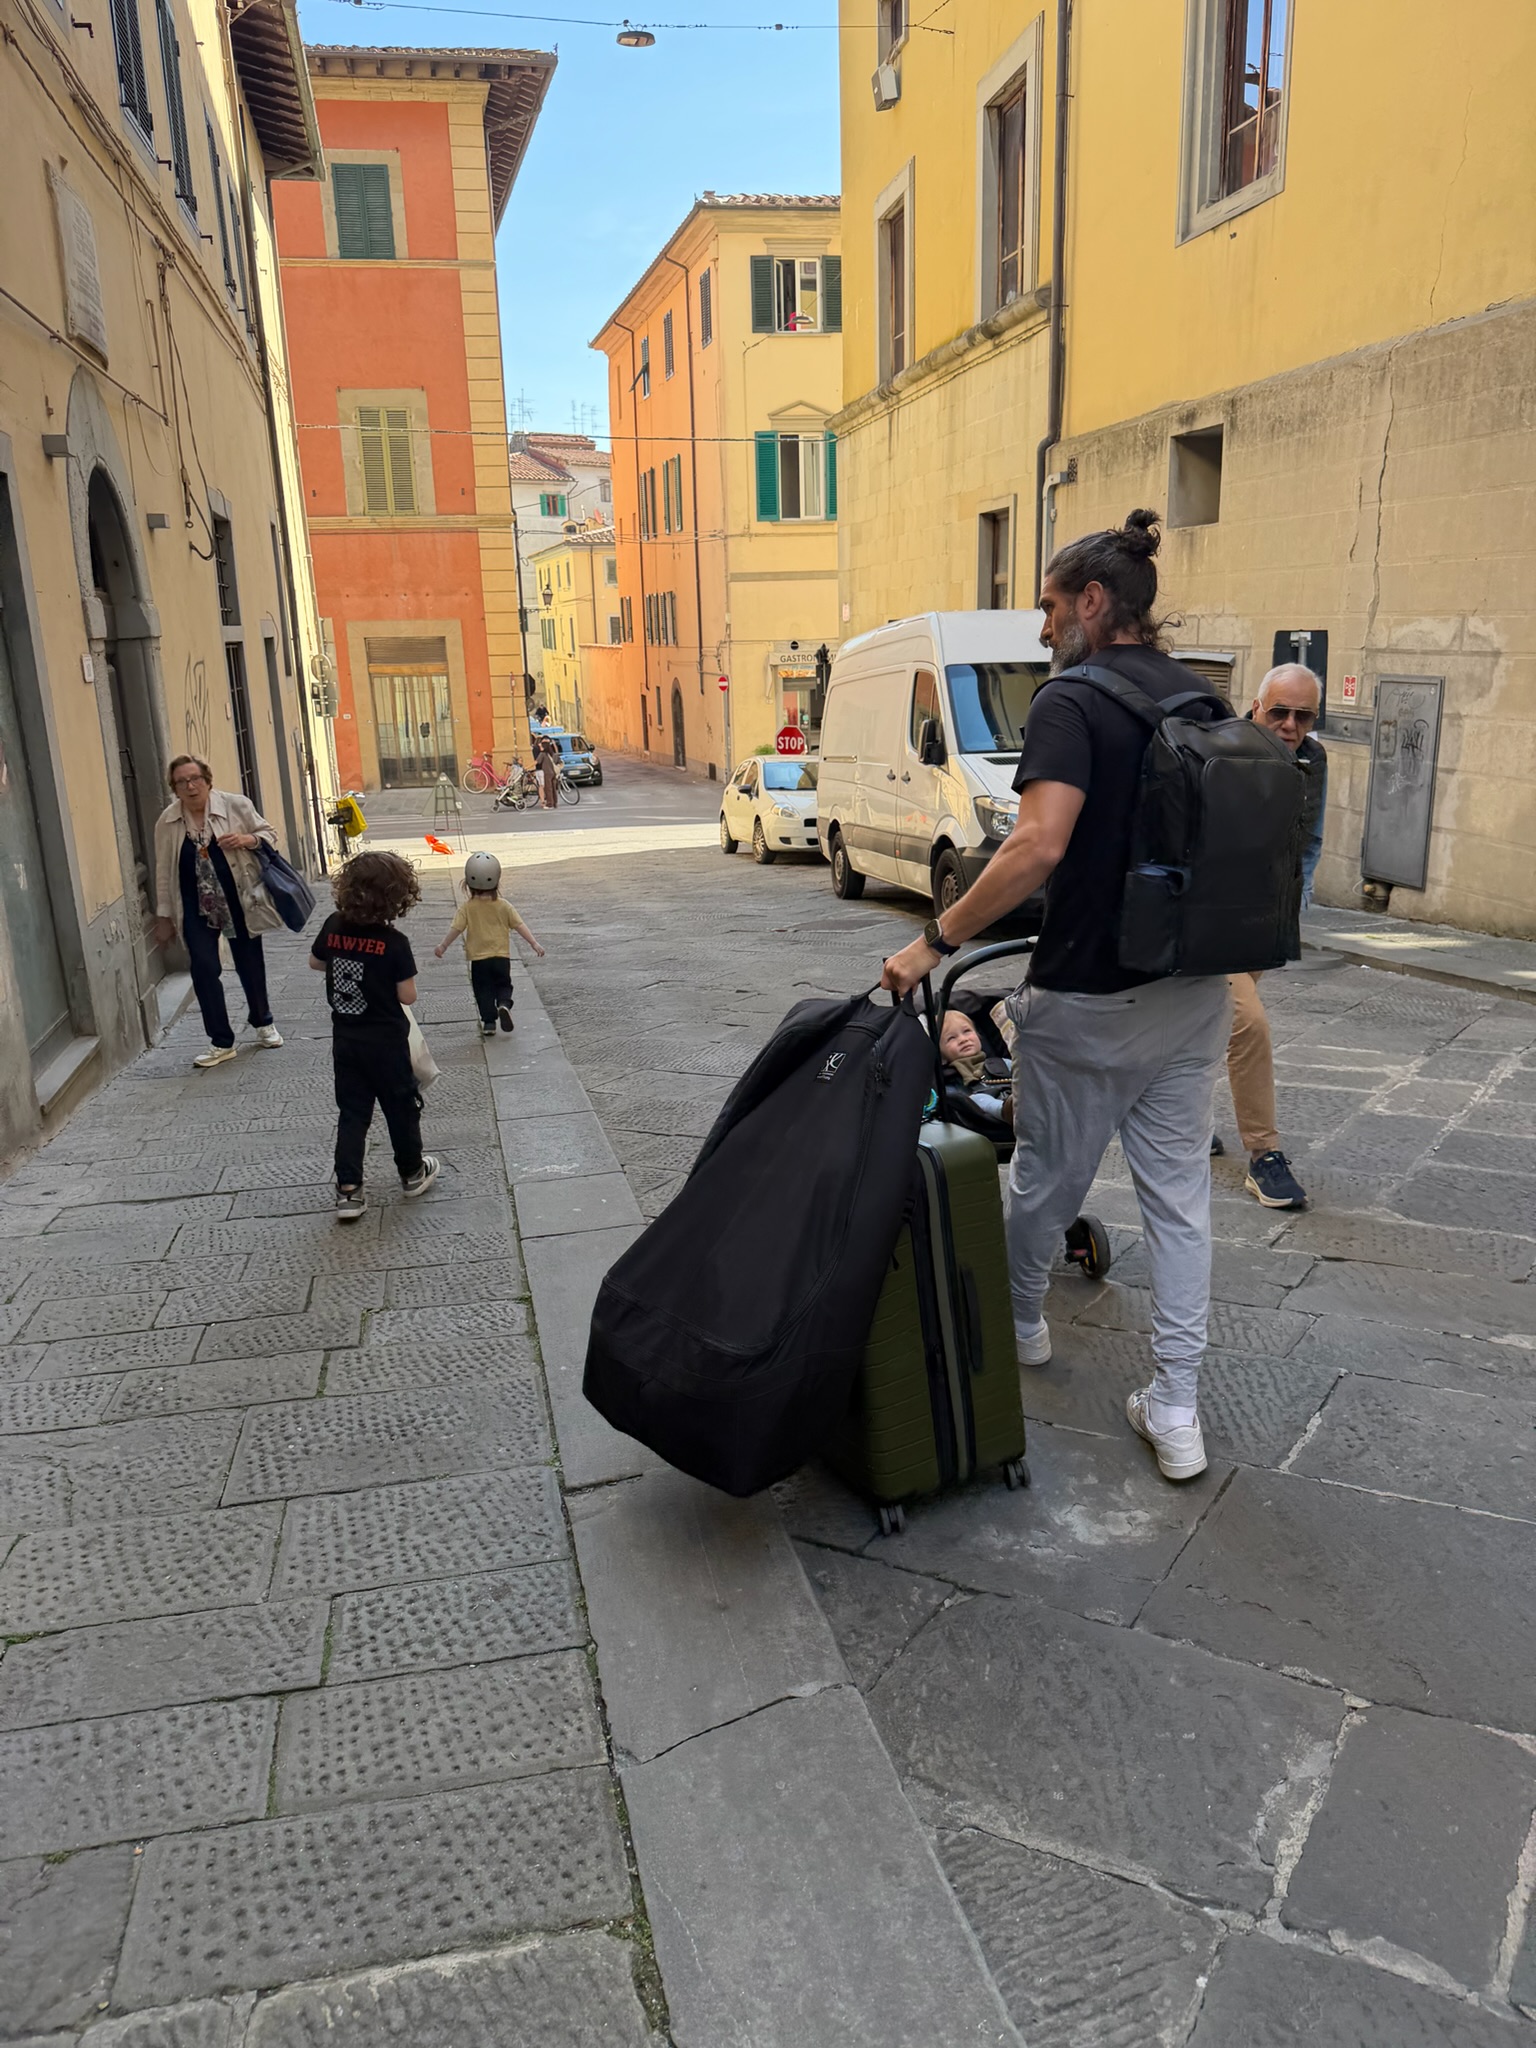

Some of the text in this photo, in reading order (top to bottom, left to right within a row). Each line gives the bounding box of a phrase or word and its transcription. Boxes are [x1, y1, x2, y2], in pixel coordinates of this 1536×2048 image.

[778, 736, 804, 750] STOP
[327, 933, 386, 955] SAWYER
[333, 956, 368, 1015] 5
